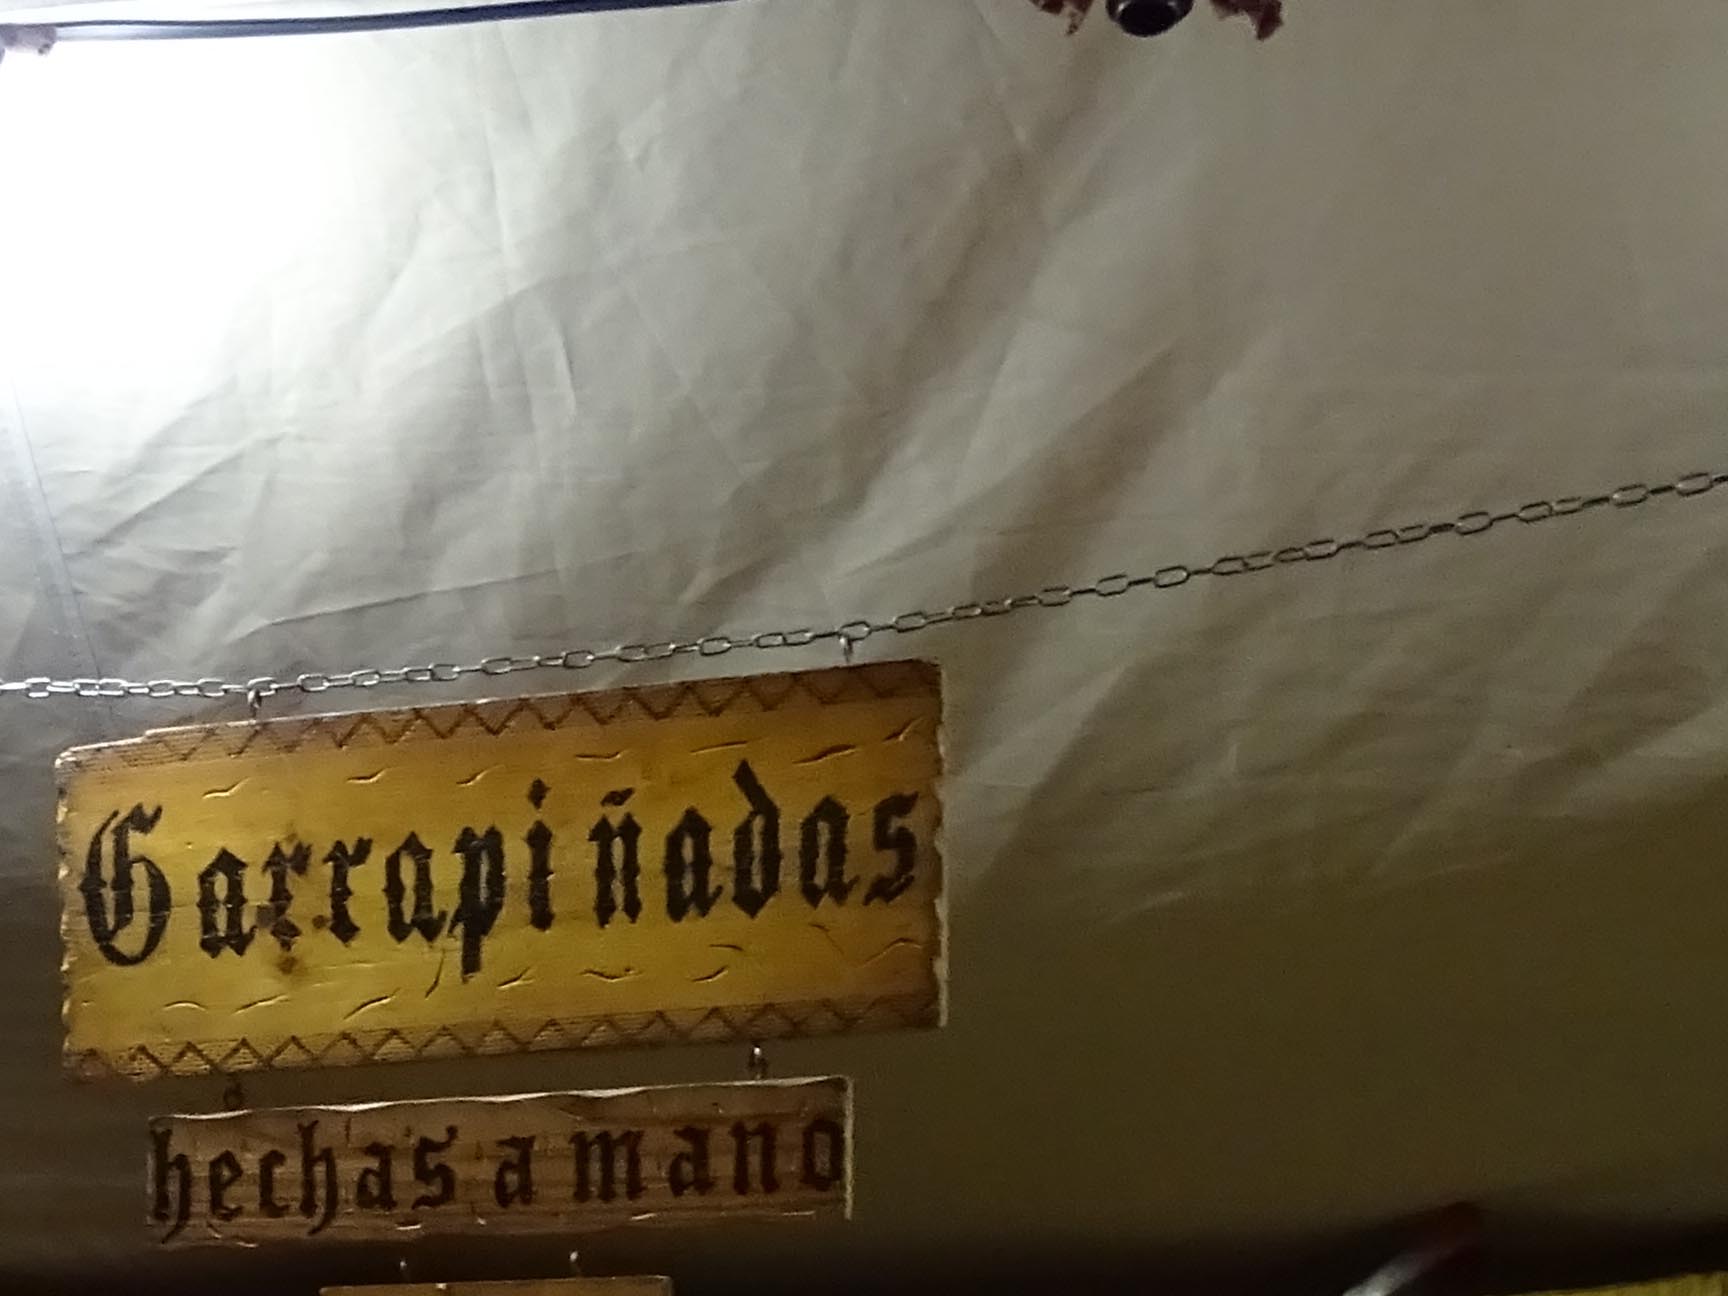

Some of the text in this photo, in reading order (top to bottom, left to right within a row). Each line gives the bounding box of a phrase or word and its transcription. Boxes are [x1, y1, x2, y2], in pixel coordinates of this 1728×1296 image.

[80, 760, 920, 982] Garrapiñadas
[148, 1116, 845, 1244] hechas a mano
